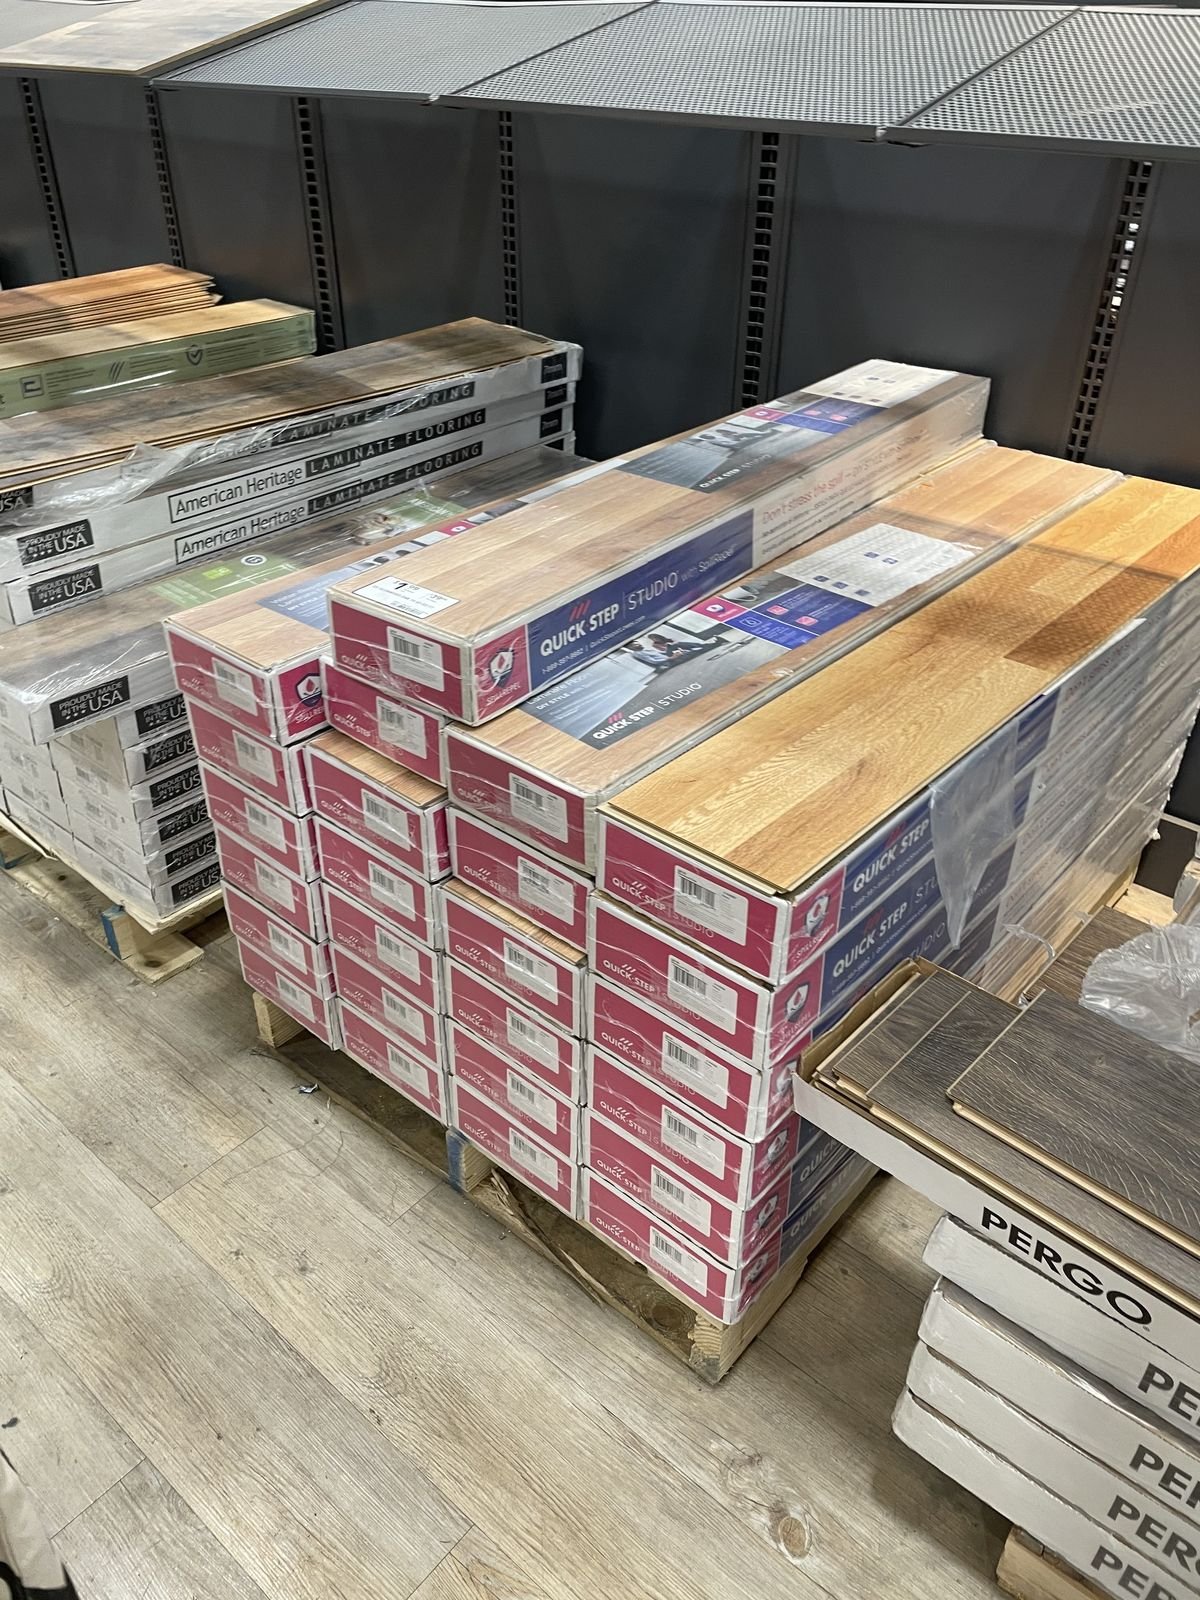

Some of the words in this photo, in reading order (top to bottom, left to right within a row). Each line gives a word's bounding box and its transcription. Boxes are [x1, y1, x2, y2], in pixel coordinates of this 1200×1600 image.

[175, 484, 243, 515] American
[247, 466, 302, 493] Heritage
[310, 437, 395, 474] LAMINATE
[406, 411, 483, 445] FLOORING
[181, 526, 247, 556] American
[251, 504, 305, 535] Heritage
[312, 473, 395, 509] LAMINATE
[405, 444, 480, 479] FLOORING
[25, 530, 61, 546] PROUDLY
[62, 524, 86, 536] MADE
[28, 546, 38, 554] IN
[38, 541, 54, 552] THE
[54, 533, 88, 552] USA
[36, 576, 71, 592] PROUDLY
[71, 569, 95, 581] MADE
[48, 587, 63, 598] THE
[64, 578, 96, 597] USA
[628, 571, 679, 610] STUDIO
[59, 689, 99, 711] PROUDLY
[99, 682, 122, 697] MADE
[61, 708, 70, 717] IN
[70, 701, 87, 715] THE
[89, 690, 123, 712] USA
[658, 683, 702, 707] STUDIO
[170, 701, 187, 718] US
[176, 739, 194, 755] US
[157, 772, 190, 790] PROUDLY
[183, 774, 201, 790] US
[190, 807, 208, 824] US
[197, 840, 215, 856] US
[202, 871, 219, 888] US
[879, 902, 907, 936] STEP
[981, 1207, 1152, 1325] PERGO
[1138, 1363, 1200, 1424] PE
[1107, 1495, 1200, 1576] PER
